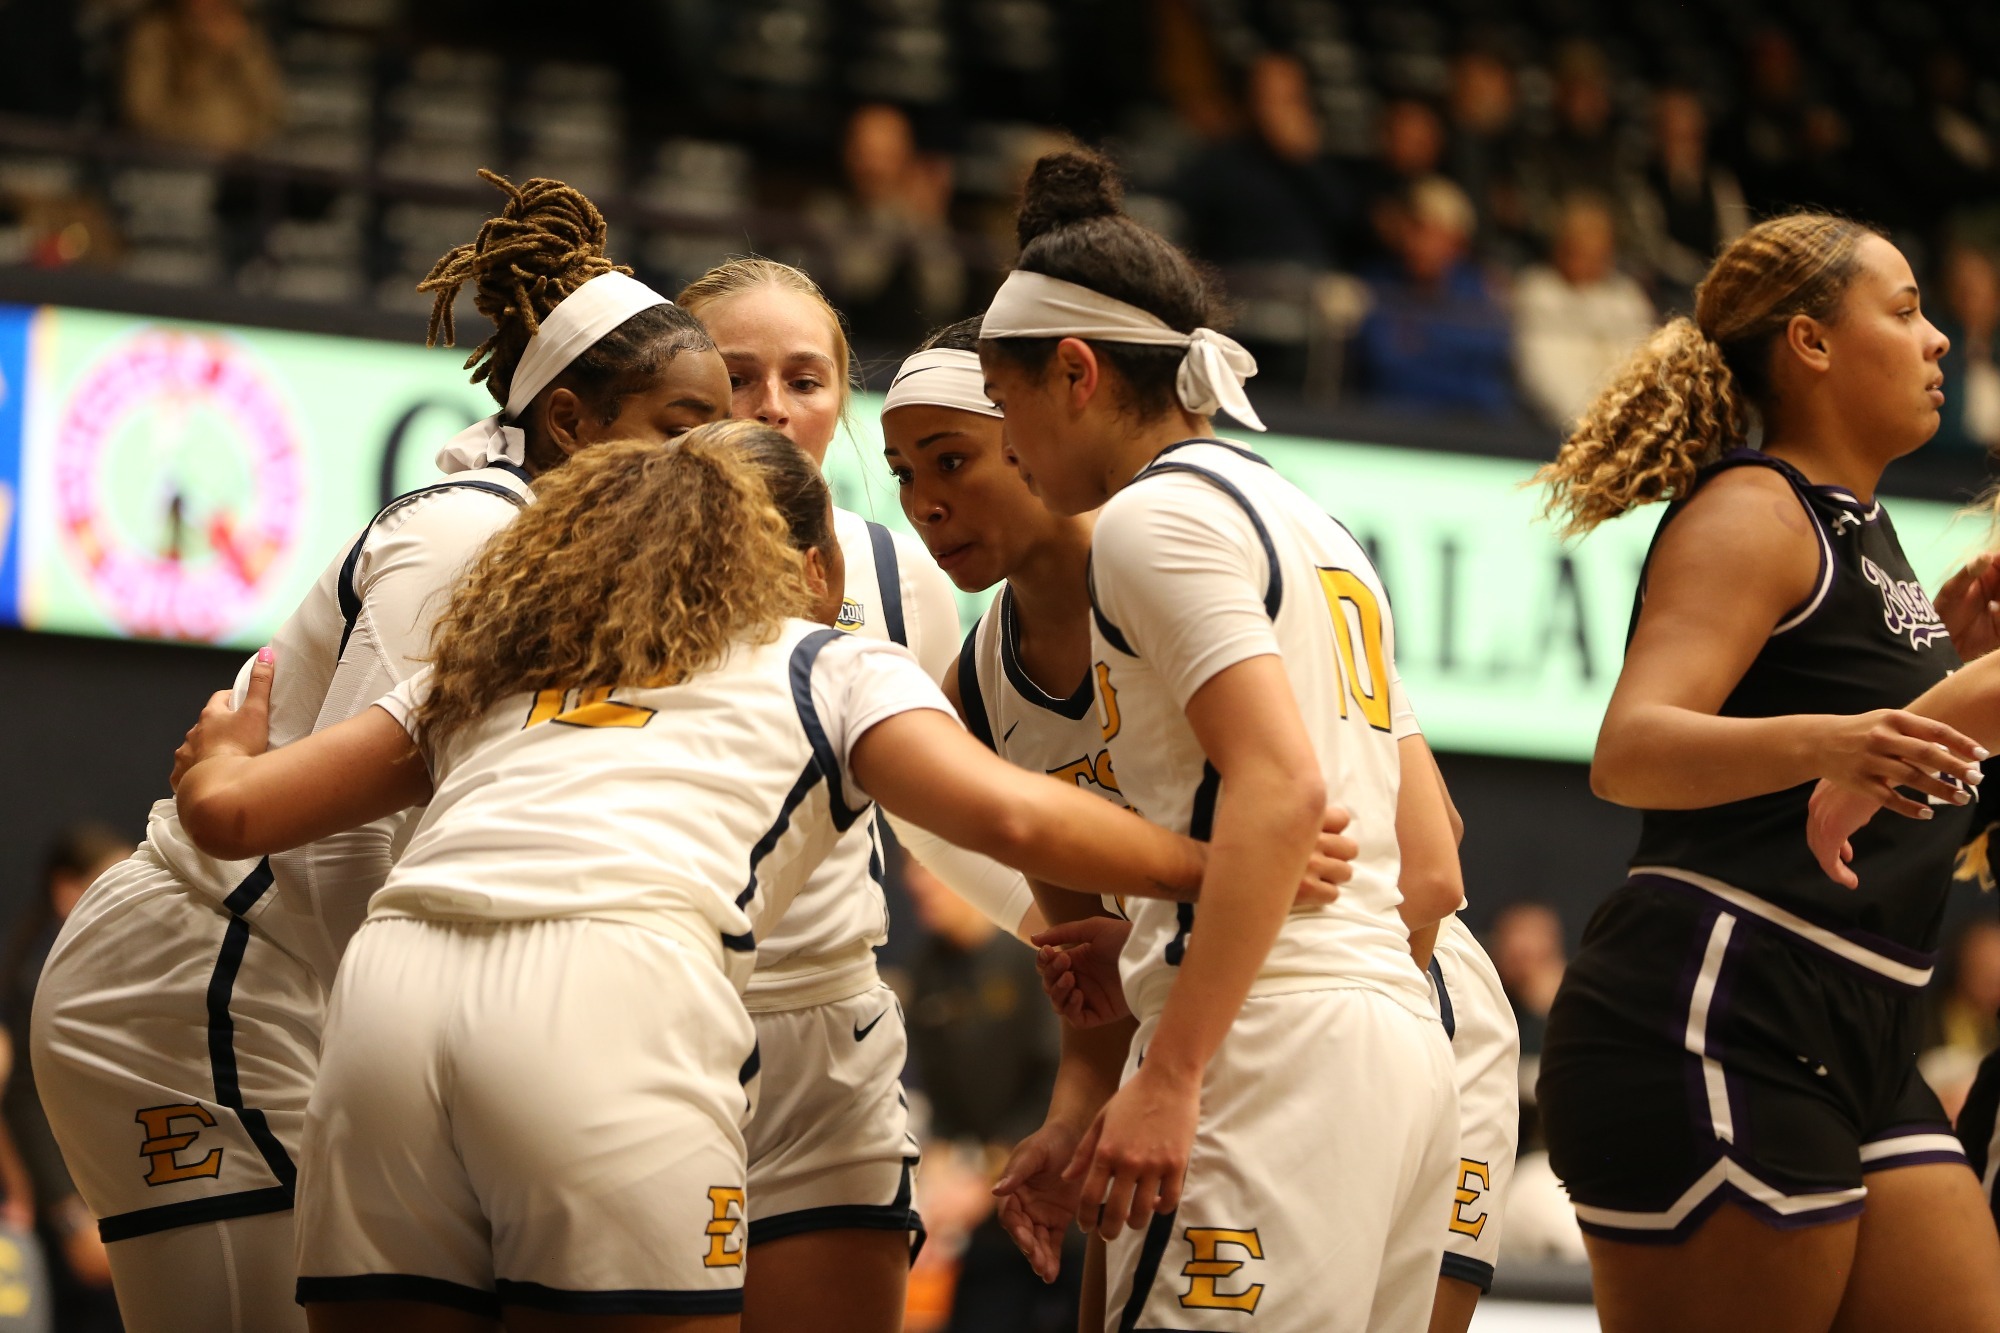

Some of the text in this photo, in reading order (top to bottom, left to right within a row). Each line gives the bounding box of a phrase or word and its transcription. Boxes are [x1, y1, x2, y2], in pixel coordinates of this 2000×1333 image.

[838, 603, 865, 625] CON
[135, 1101, 224, 1187] E
[702, 1185, 745, 1269] E
[1448, 1157, 1490, 1242] E
[1178, 1227, 1265, 1316] E
